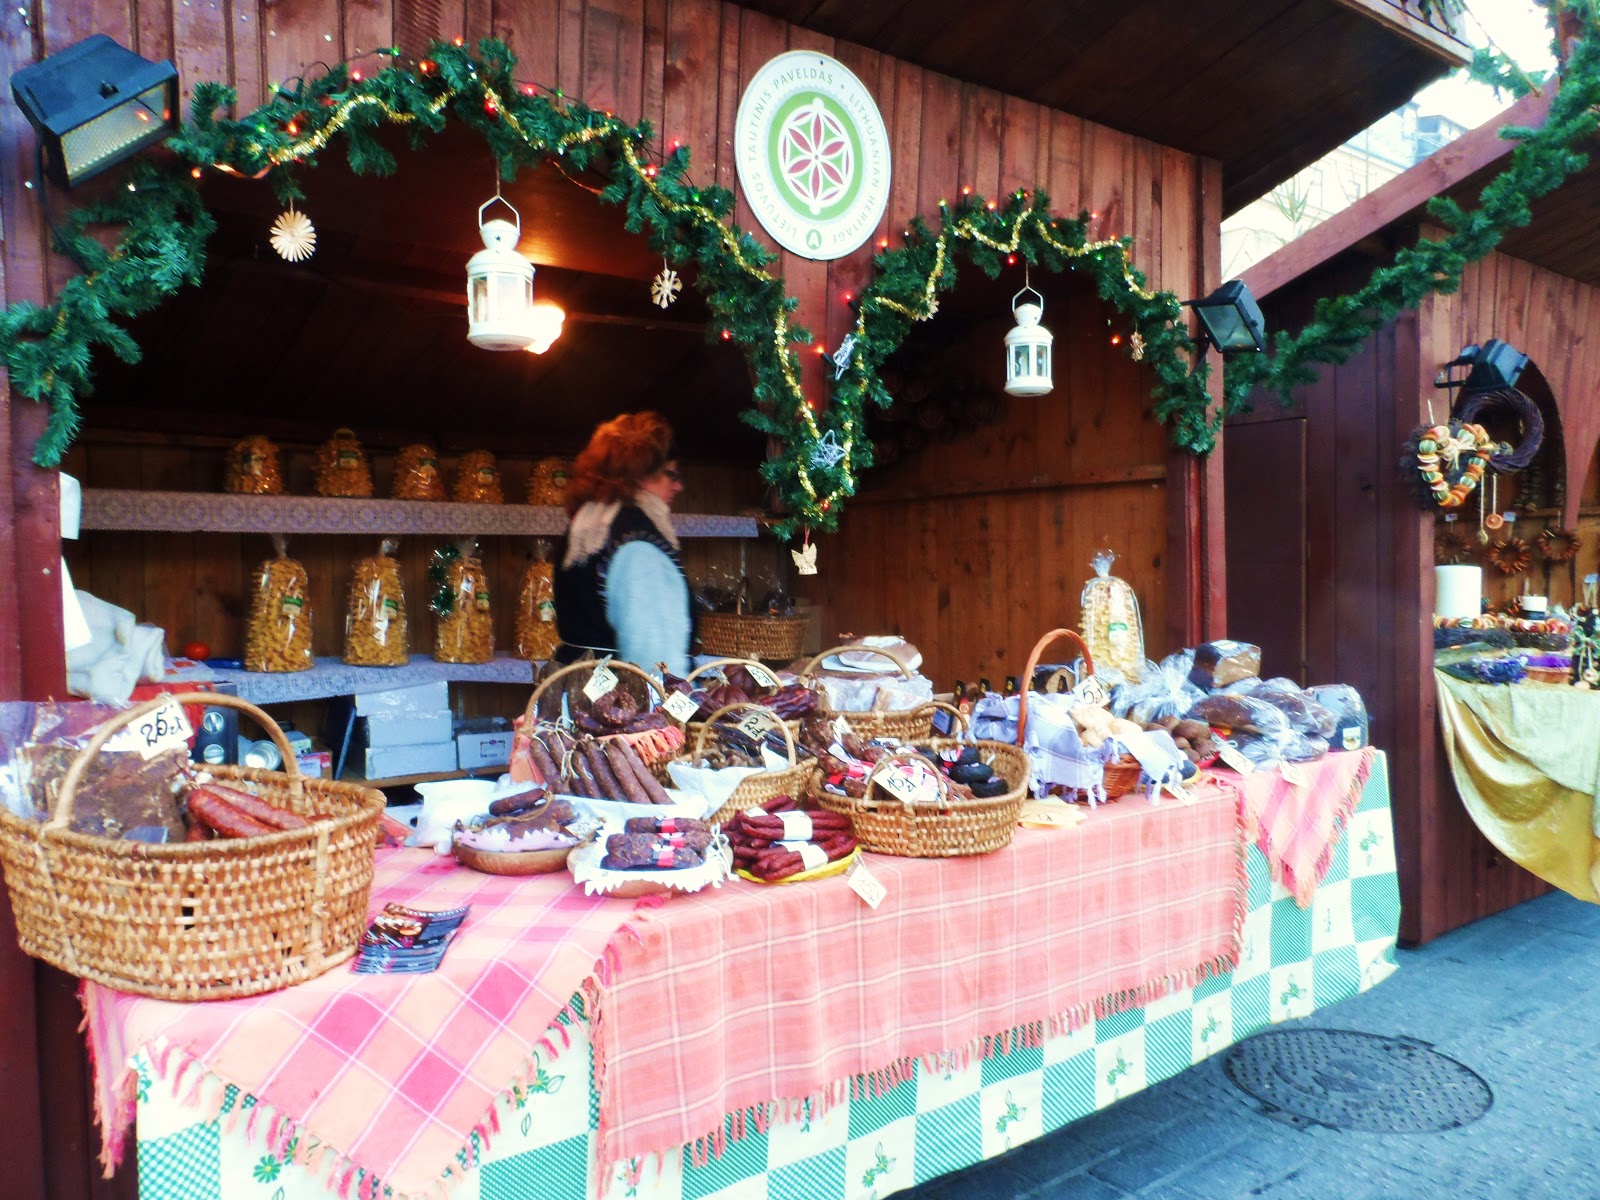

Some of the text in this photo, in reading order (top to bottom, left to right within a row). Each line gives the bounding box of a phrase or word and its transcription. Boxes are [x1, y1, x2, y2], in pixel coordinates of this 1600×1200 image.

[748, 67, 834, 239] LIETUVOS TAUTINIS PAVELDAS
[831, 93, 881, 245] LITHUANIAN HERITAGE
[886, 772, 905, 792] 15
